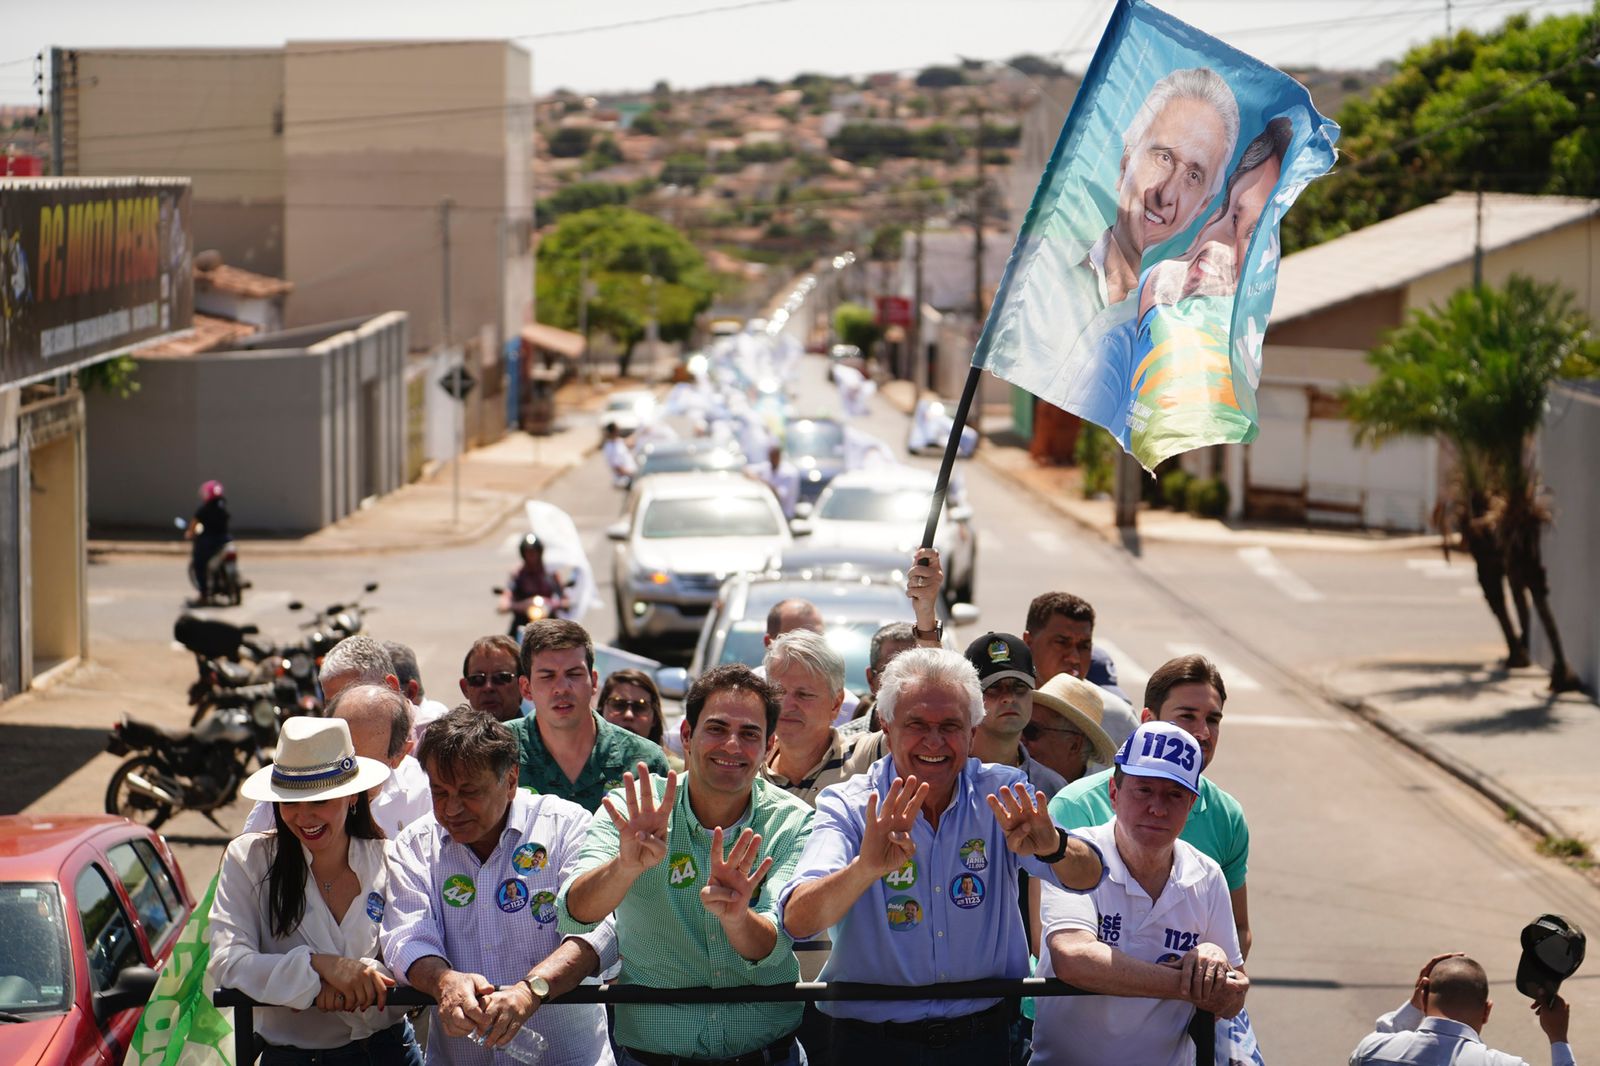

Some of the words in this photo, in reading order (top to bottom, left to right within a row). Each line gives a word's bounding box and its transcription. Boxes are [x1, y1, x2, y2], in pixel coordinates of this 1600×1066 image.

[66, 199, 114, 296] MOTO
[1141, 732, 1196, 772] 1123
[670, 861, 696, 884] 44
[886, 867, 914, 886] 44
[443, 886, 473, 906] 44
[510, 899, 525, 909] 1123
[964, 896, 981, 904] 1123
[1164, 928, 1200, 951] 1123
